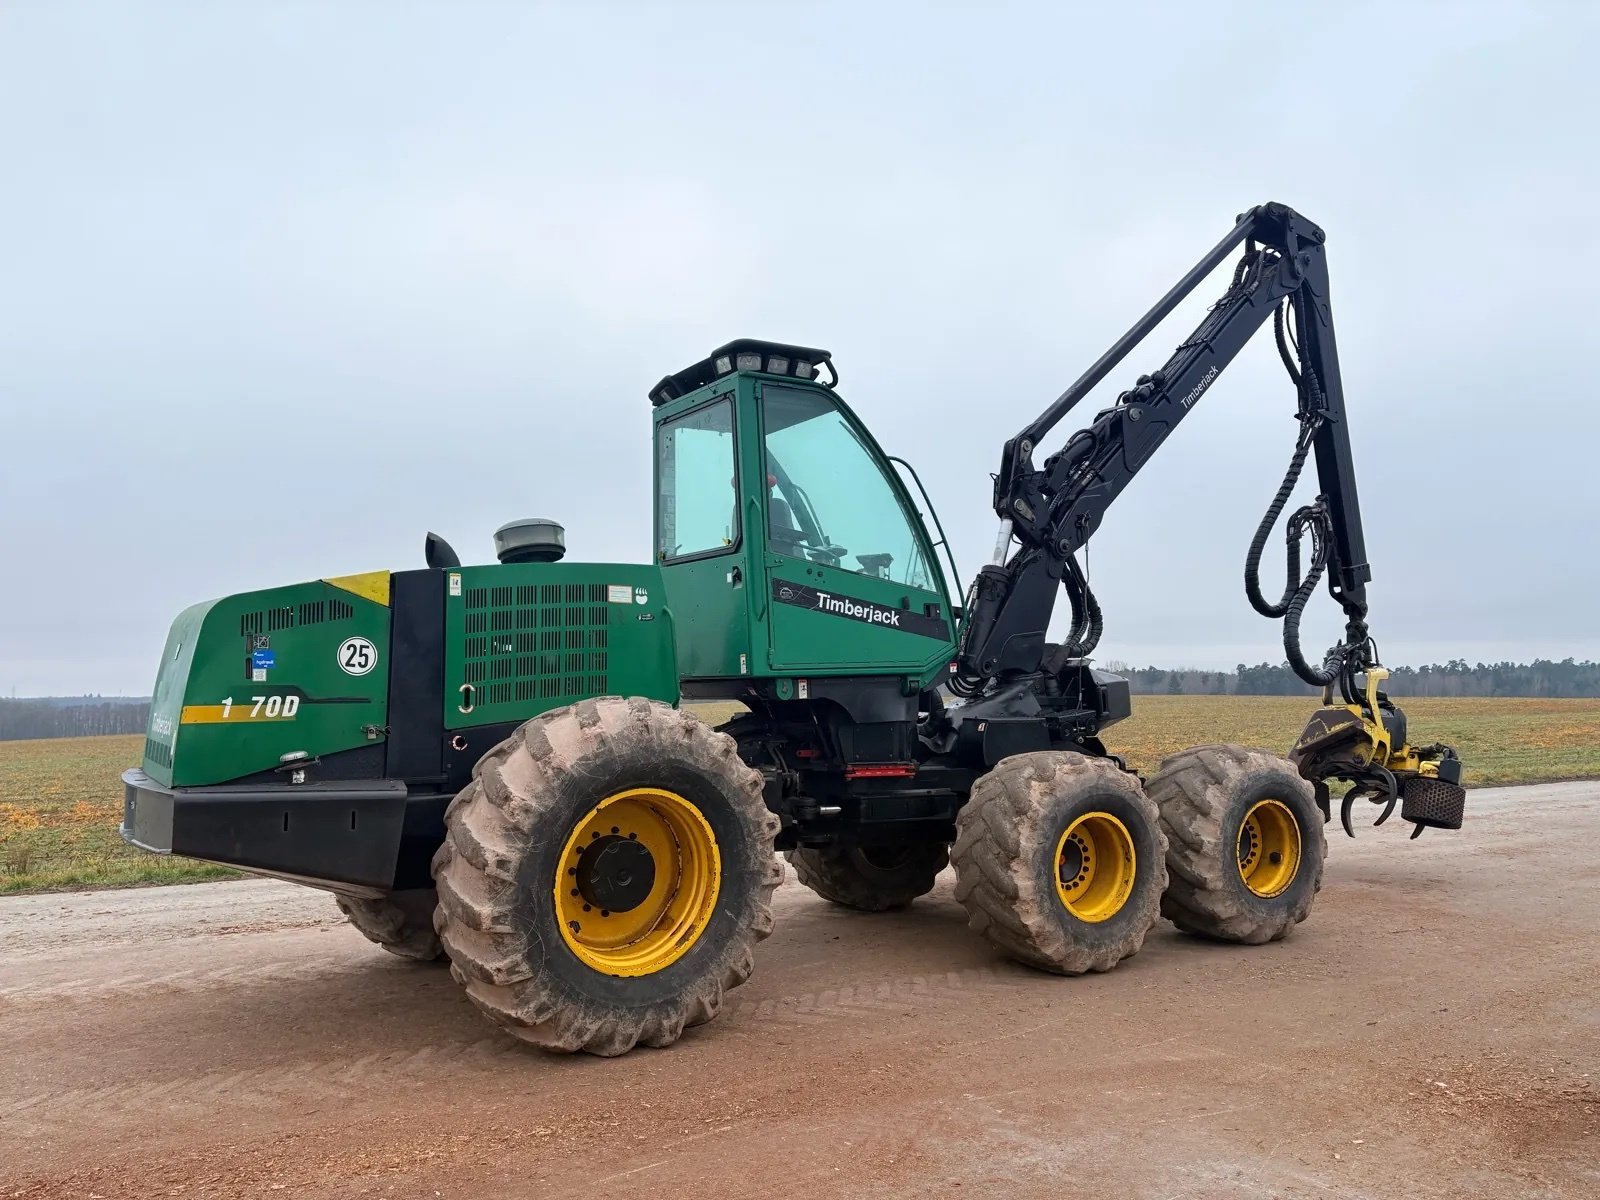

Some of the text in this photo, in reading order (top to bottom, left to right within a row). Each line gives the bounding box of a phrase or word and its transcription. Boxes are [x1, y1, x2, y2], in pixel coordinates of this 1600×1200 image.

[1180, 365, 1219, 409] Timberjack
[816, 592, 900, 626] Timberjack
[345, 643, 370, 669] 25
